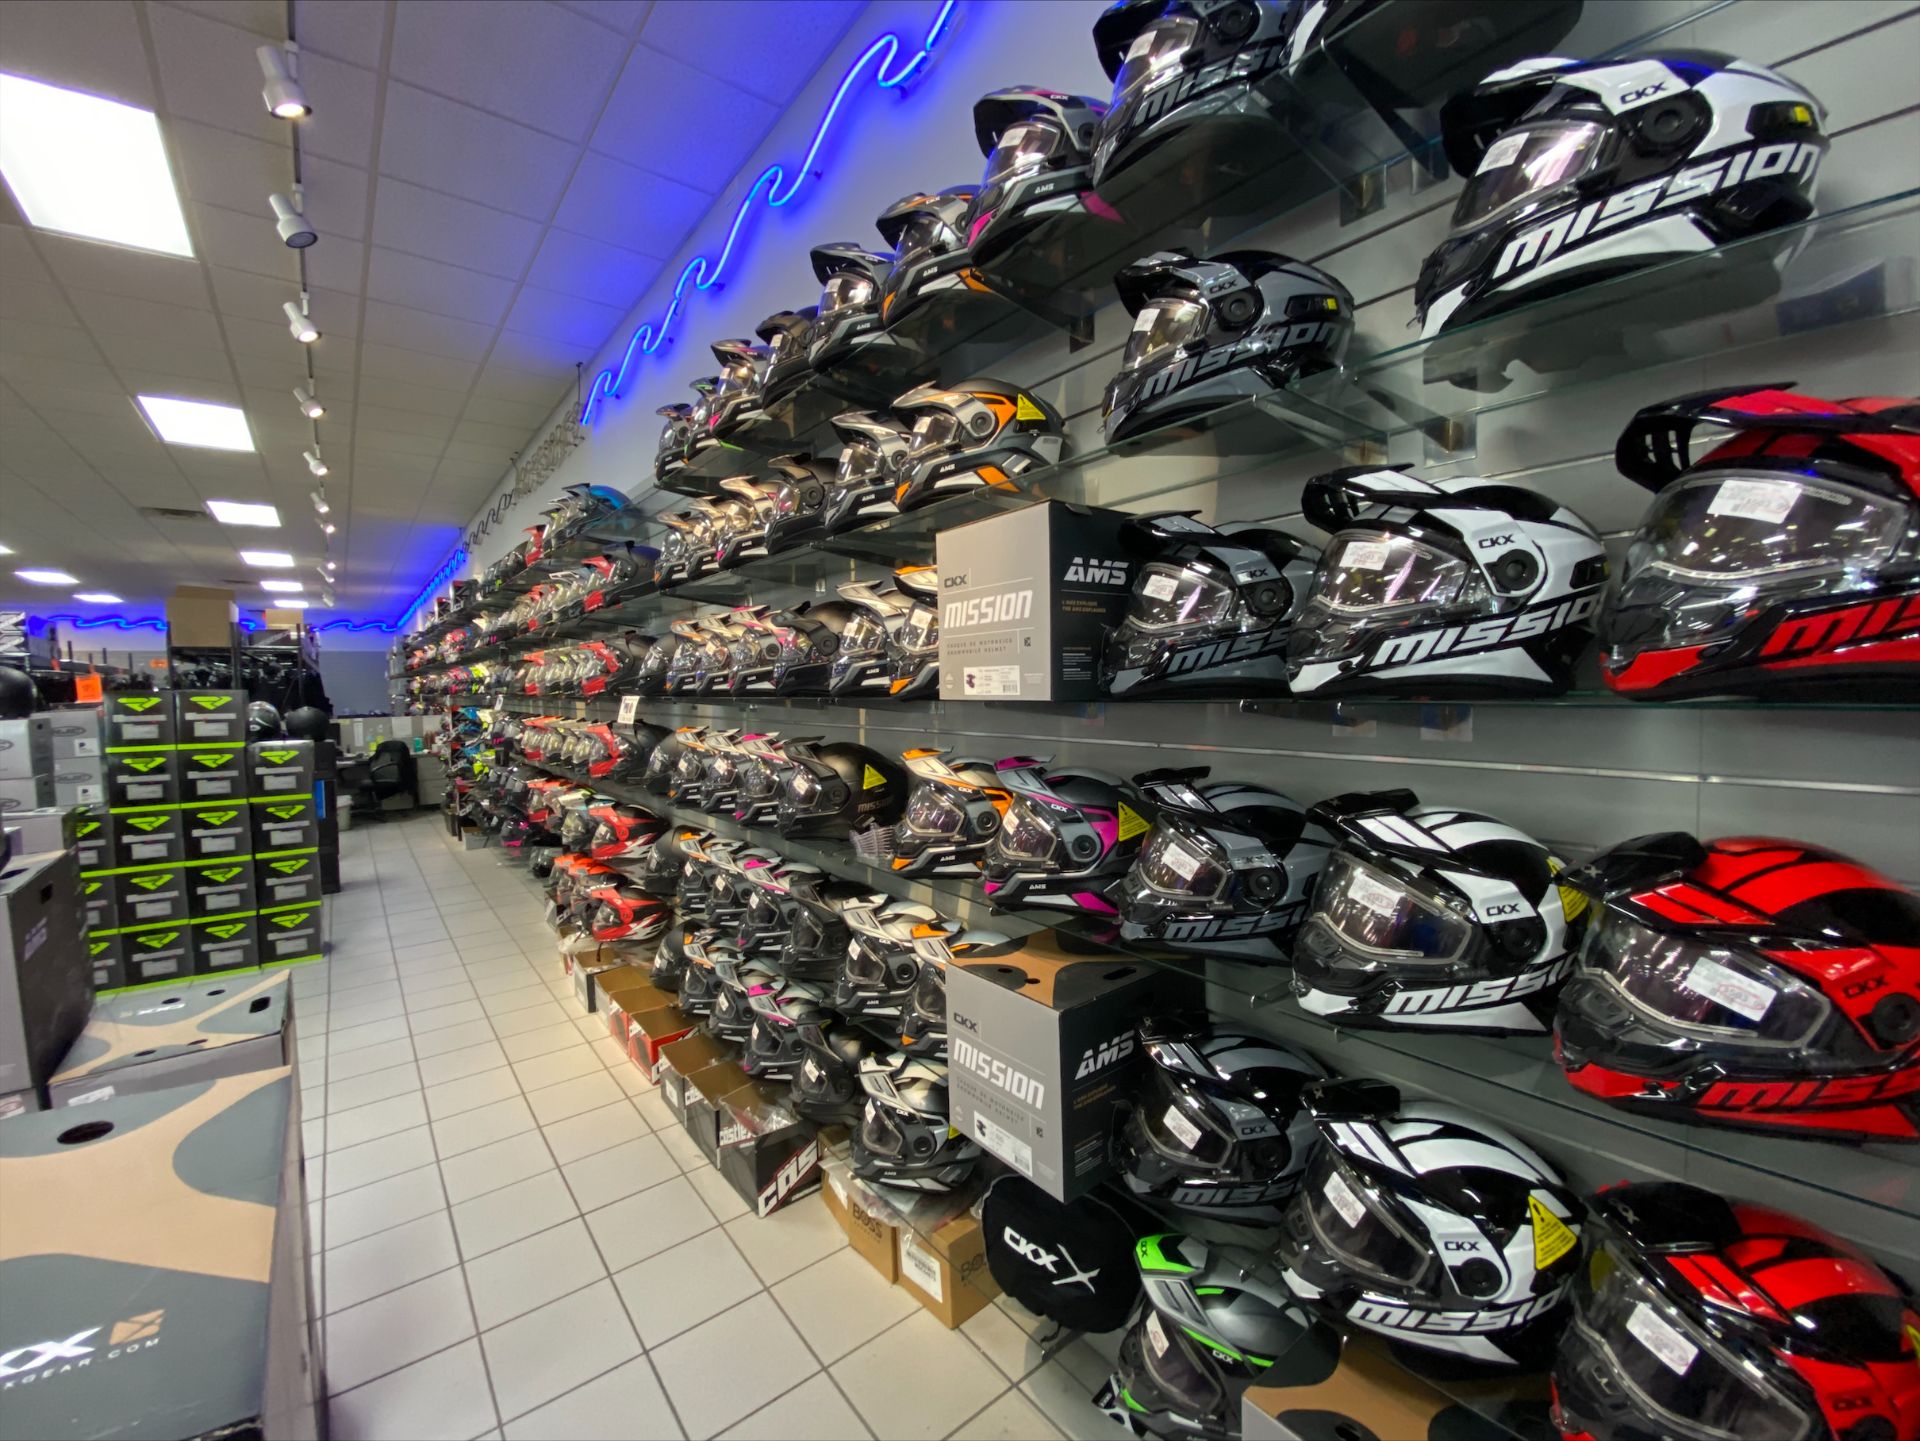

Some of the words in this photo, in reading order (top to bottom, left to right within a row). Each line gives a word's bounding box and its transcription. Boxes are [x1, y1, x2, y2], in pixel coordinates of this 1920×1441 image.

[1620, 81, 1667, 105] CKX
[1493, 142, 1820, 280] MISSION
[1209, 279, 1237, 294] CKX
[1478, 533, 1515, 549] CKX
[944, 573, 968, 588] CKX
[1063, 556, 1131, 586] AMS
[944, 589, 1034, 630] MISSION
[1370, 592, 1600, 667] MISSIO
[1051, 803, 1068, 813] CKX
[1486, 902, 1521, 917] CKX
[1843, 976, 1889, 999] CKX
[953, 1012, 978, 1033] CKX
[1074, 1029, 1135, 1081] AMS
[953, 1037, 1046, 1111] MISSION
[1241, 1125, 1267, 1135] CKX
[852, 1202, 883, 1239] BOSS
[1003, 1225, 1060, 1274] CKX
[1443, 1240, 1481, 1252] CKX
[1346, 1287, 1563, 1333] MISSIO
[1212, 1349, 1234, 1365] CKX
